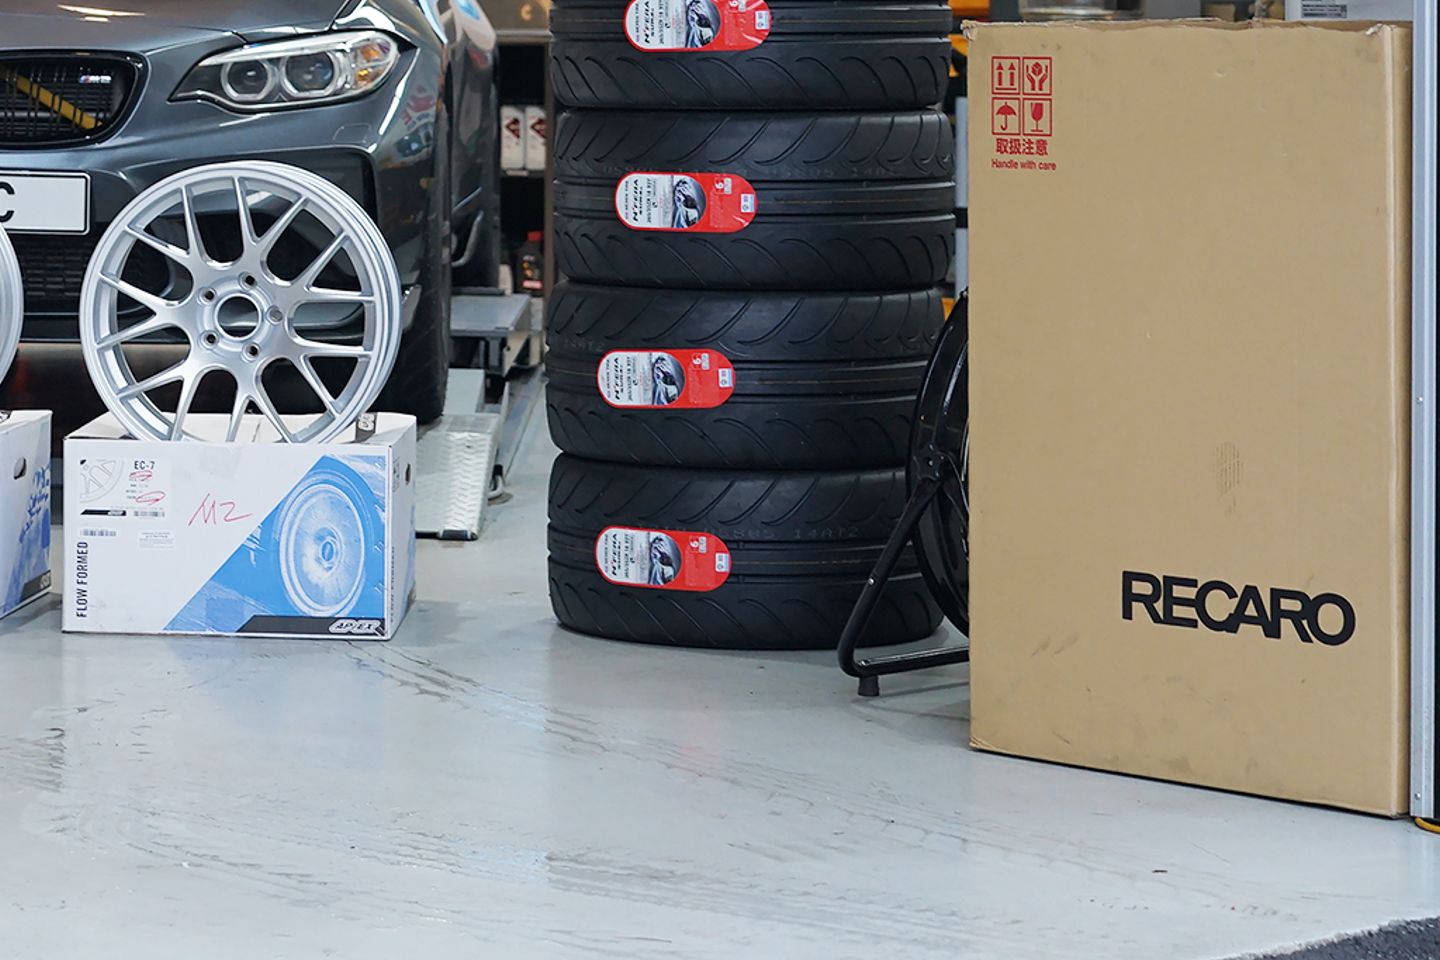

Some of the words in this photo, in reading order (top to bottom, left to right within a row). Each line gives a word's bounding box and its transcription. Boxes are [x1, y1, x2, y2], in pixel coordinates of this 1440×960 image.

[996, 138, 1048, 156] 取扱注意
[991, 158, 1018, 169] Handle
[1020, 159, 1037, 169] with
[1038, 161, 1057, 171] care
[134, 460, 155, 470] EC-7
[188, 493, 252, 526] M2
[76, 541, 89, 585] FORMED
[76, 589, 88, 618] FLOW
[1122, 570, 1356, 646] RECARO
